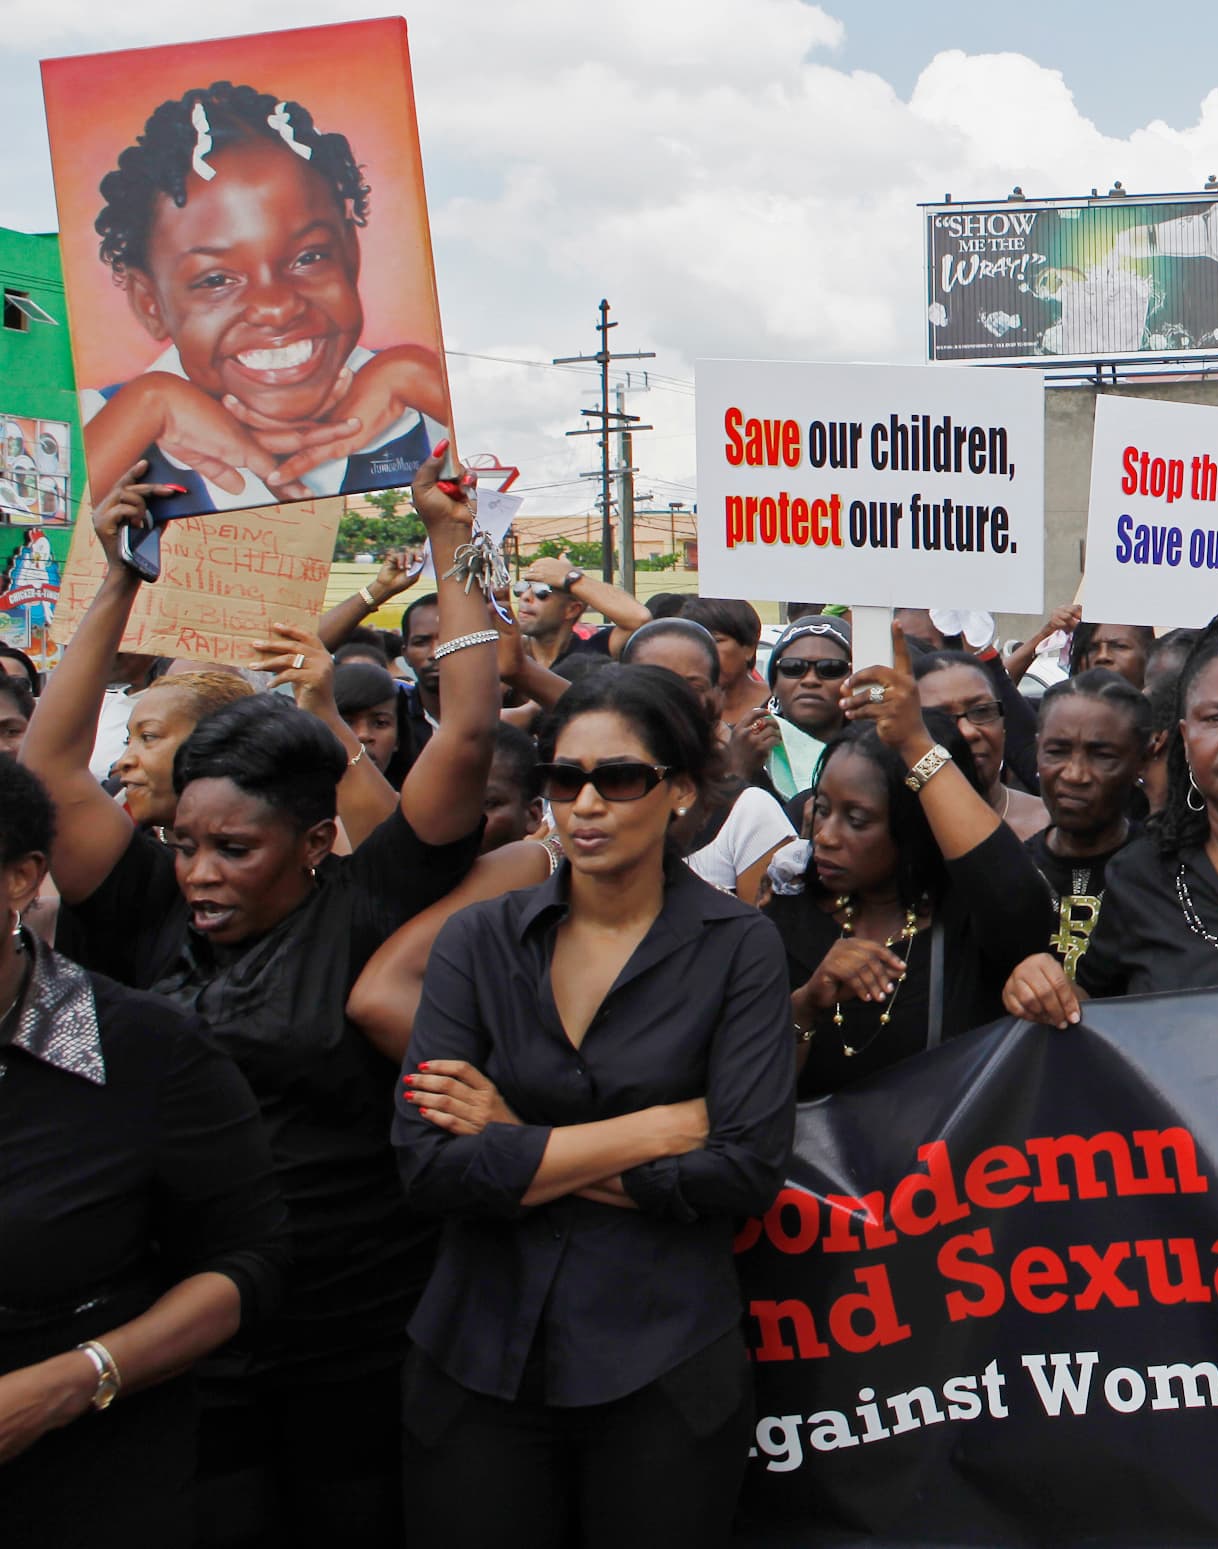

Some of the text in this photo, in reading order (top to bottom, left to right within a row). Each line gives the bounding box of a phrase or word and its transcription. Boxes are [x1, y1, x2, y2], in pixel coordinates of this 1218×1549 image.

[959, 238, 1025, 252] ME THE
[724, 407, 1015, 481] Save our children,
[1121, 446, 1184, 503] Stop
[725, 491, 1017, 554] protect our future.
[1116, 514, 1183, 567] Save
[747, 1264, 912, 1362] nd
[748, 1359, 1009, 1473] gainst
